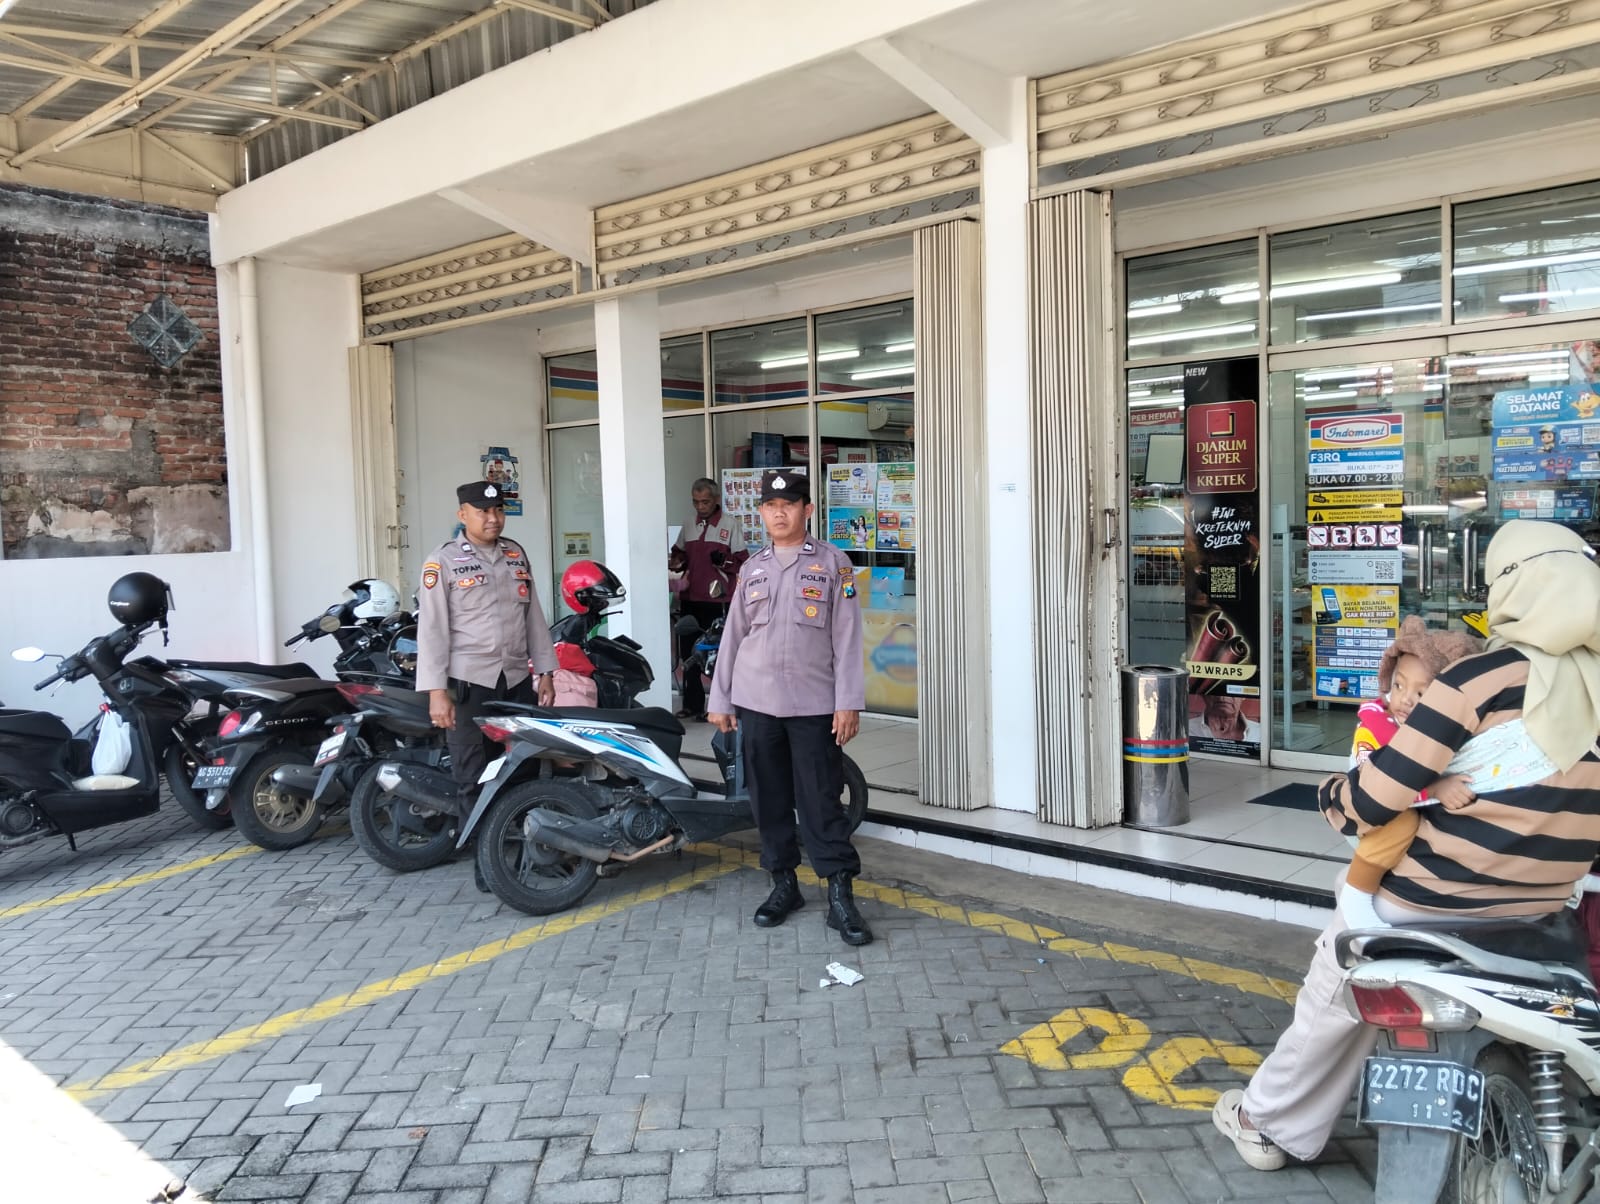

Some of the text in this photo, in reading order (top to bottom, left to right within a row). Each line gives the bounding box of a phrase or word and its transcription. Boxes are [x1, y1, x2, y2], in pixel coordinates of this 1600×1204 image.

[1185, 366, 1208, 377] NEW
[1506, 391, 1564, 405] SELAMAT
[1510, 401, 1561, 414] DATANG
[1148, 411, 1178, 421] HEMAT
[1326, 426, 1386, 439] Indomaret
[1196, 440, 1248, 454] DJARUM
[1201, 453, 1241, 465] SUPER
[1310, 452, 1341, 463] F3RQ
[1197, 474, 1247, 488] KRETEK
[1309, 475, 1339, 485] BUKA
[1340, 474, 1368, 484] 07.00
[1375, 473, 1405, 482] 22.00
[1211, 506, 1236, 520] #INI
[1203, 533, 1243, 549] SUPER
[801, 574, 827, 583] POLRI
[1191, 665, 1244, 677] 12 WRAPS
[1369, 1063, 1479, 1102] 2272 RDC
